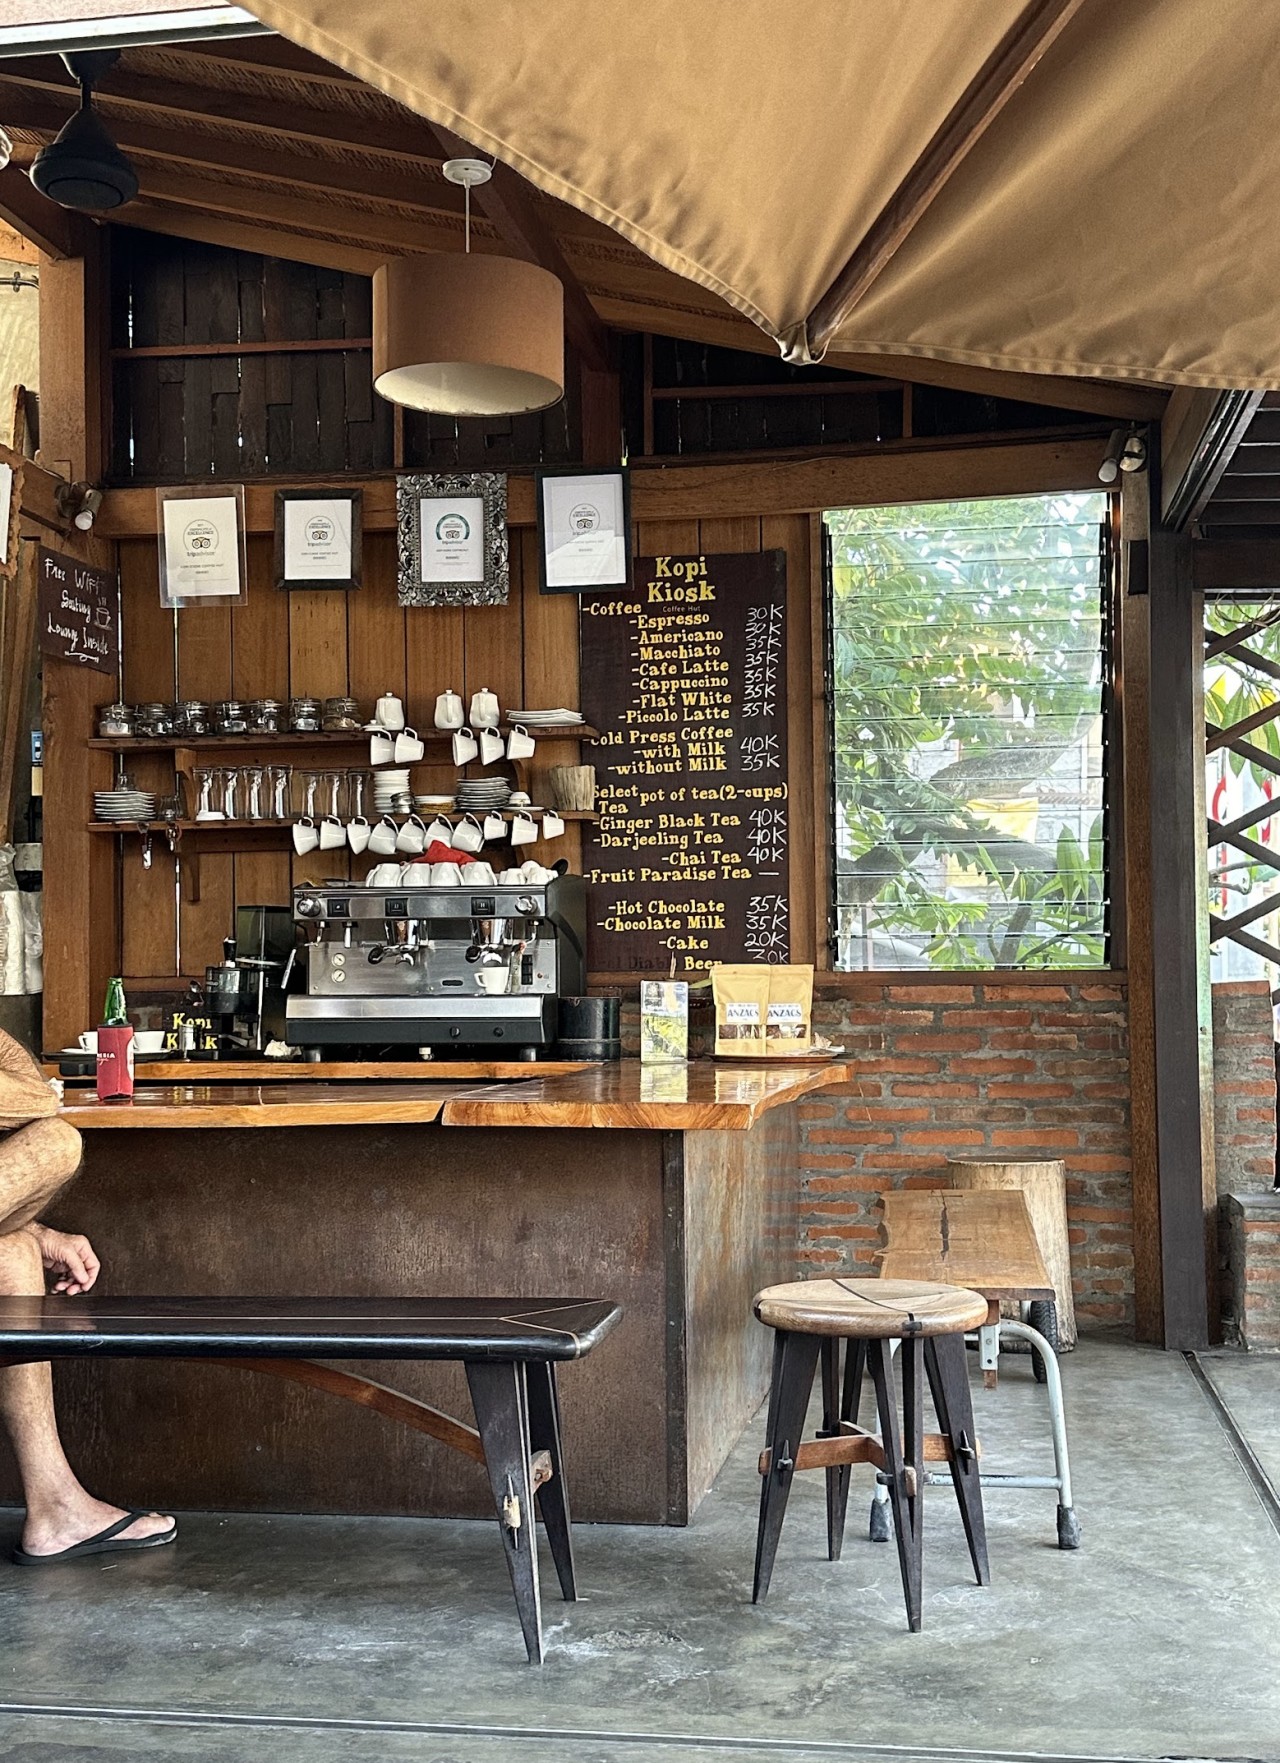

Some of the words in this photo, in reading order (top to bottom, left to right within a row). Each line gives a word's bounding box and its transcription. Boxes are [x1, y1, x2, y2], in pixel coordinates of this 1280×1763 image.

[655, 556, 708, 583] Kopi
[647, 580, 716, 603] Kiosk
[663, 605, 686, 613] Coffee
[747, 603, 784, 622] 30K
[745, 635, 782, 651] 35K
[682, 659, 729, 674] Latte
[744, 650, 779, 668] 35K
[744, 666, 777, 684] 35K
[681, 691, 732, 706] White
[743, 683, 776, 700] 35K
[683, 706, 730, 721] Latte
[742, 701, 775, 718] 35K
[629, 730, 677, 744] Press
[681, 726, 734, 740] Coffee
[687, 741, 727, 756] Milk
[740, 734, 779, 754] 40K
[689, 757, 727, 772] Milk
[740, 752, 780, 772] 35K
[640, 788, 665, 807] pot
[670, 787, 686, 801] of
[598, 801, 629, 814] Tea
[658, 813, 705, 829] Black
[710, 812, 741, 826] Tea
[749, 808, 787, 827] 40K
[693, 830, 724, 844] Tea
[746, 826, 787, 846] 40K
[711, 850, 741, 864] Tea
[747, 846, 784, 864] 40K
[640, 867, 716, 882] Paradise
[721, 866, 752, 879] Tea
[648, 899, 725, 915] Chocolate
[746, 894, 789, 914] 35K
[687, 915, 726, 930] Milk
[745, 913, 788, 931] 35K
[744, 931, 789, 949] 20K
[767, 1009, 802, 1018] ANZACS
